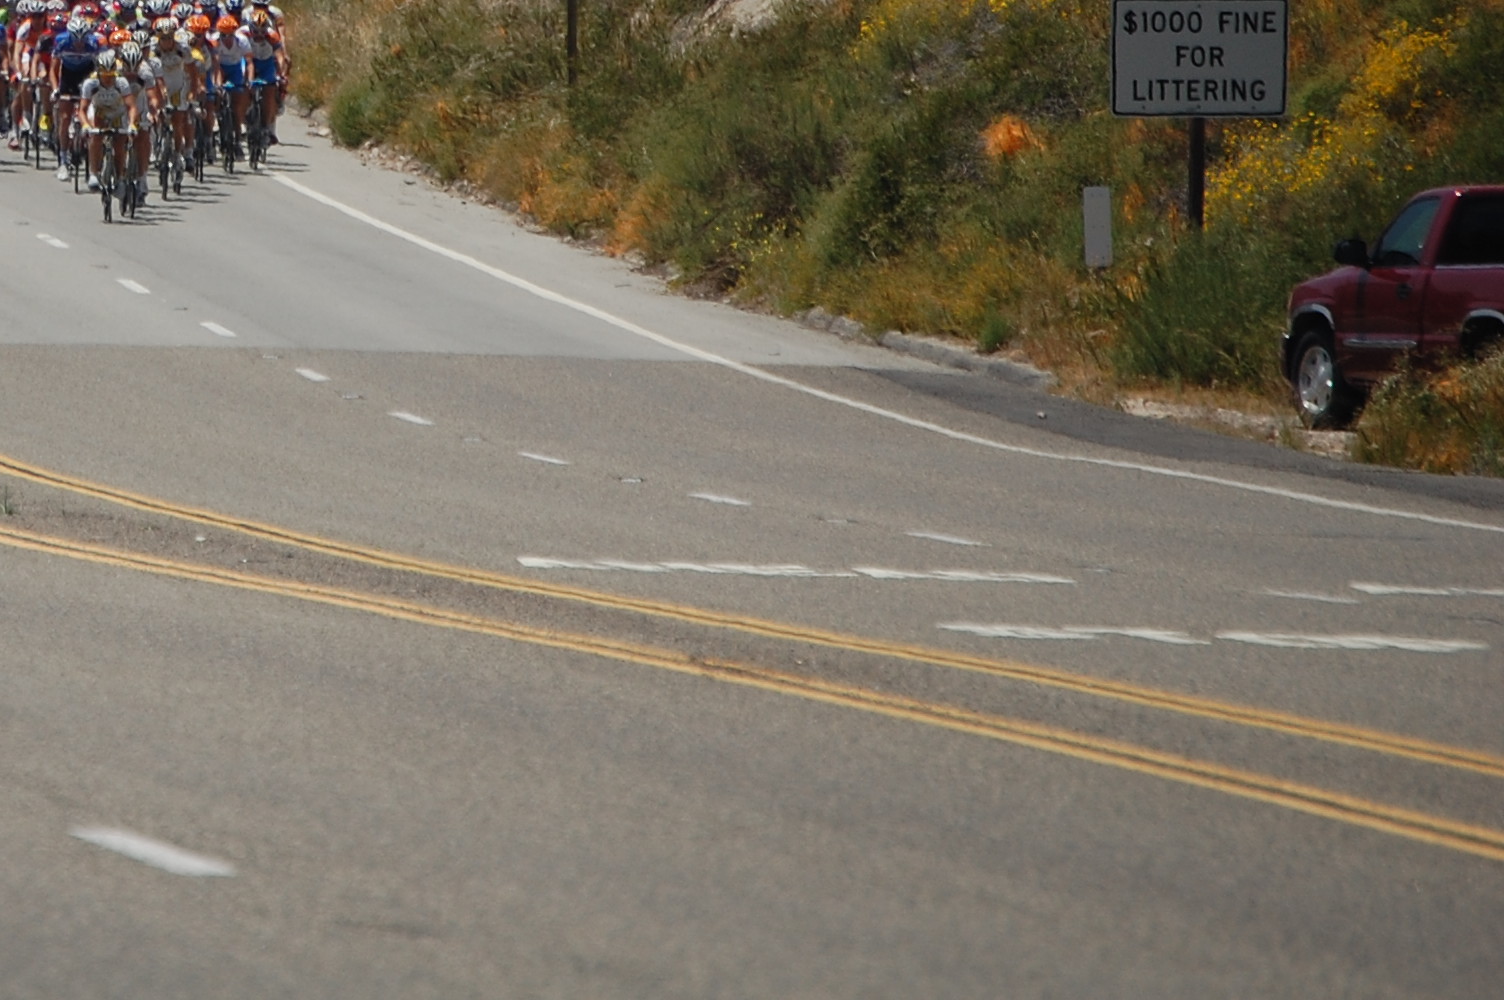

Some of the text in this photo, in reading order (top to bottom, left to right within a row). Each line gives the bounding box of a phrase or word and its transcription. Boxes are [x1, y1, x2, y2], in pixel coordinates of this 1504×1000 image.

[1123, 10, 1277, 35] $1000 FINE
[1175, 45, 1224, 67] FOR
[1132, 79, 1266, 102] LITTERING
